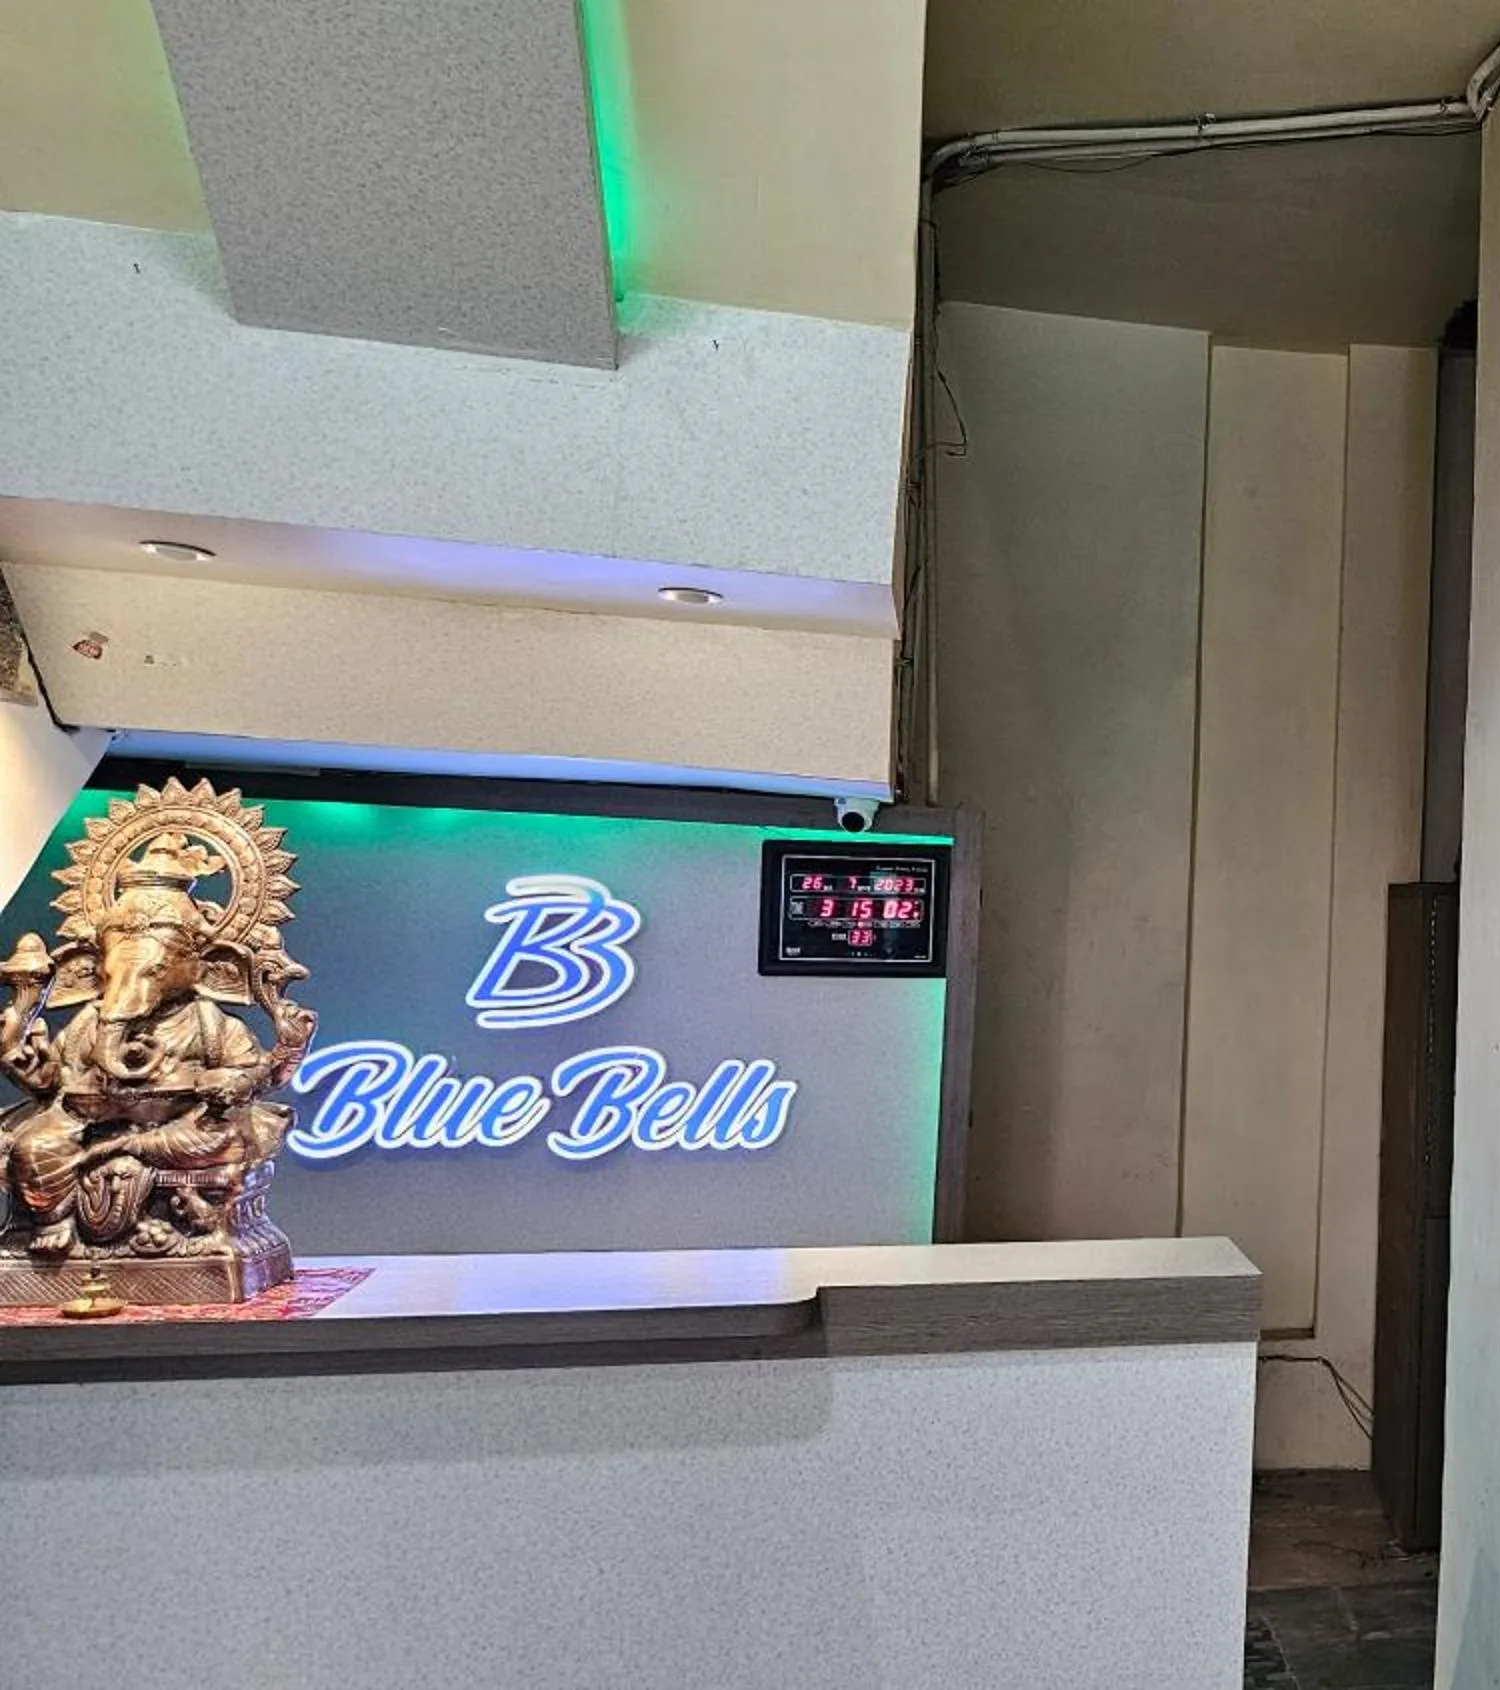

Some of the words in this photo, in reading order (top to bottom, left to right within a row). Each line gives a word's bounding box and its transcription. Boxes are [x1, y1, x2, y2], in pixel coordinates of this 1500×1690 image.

[802, 876, 823, 889] 26
[874, 879, 915, 891] 2023
[820, 900, 834, 917] 3
[851, 900, 873, 919] 15
[883, 901, 913, 919] 02
[851, 931, 871, 945] 33
[287, 1040, 550, 1158] Blue
[548, 1046, 797, 1160] Bells
